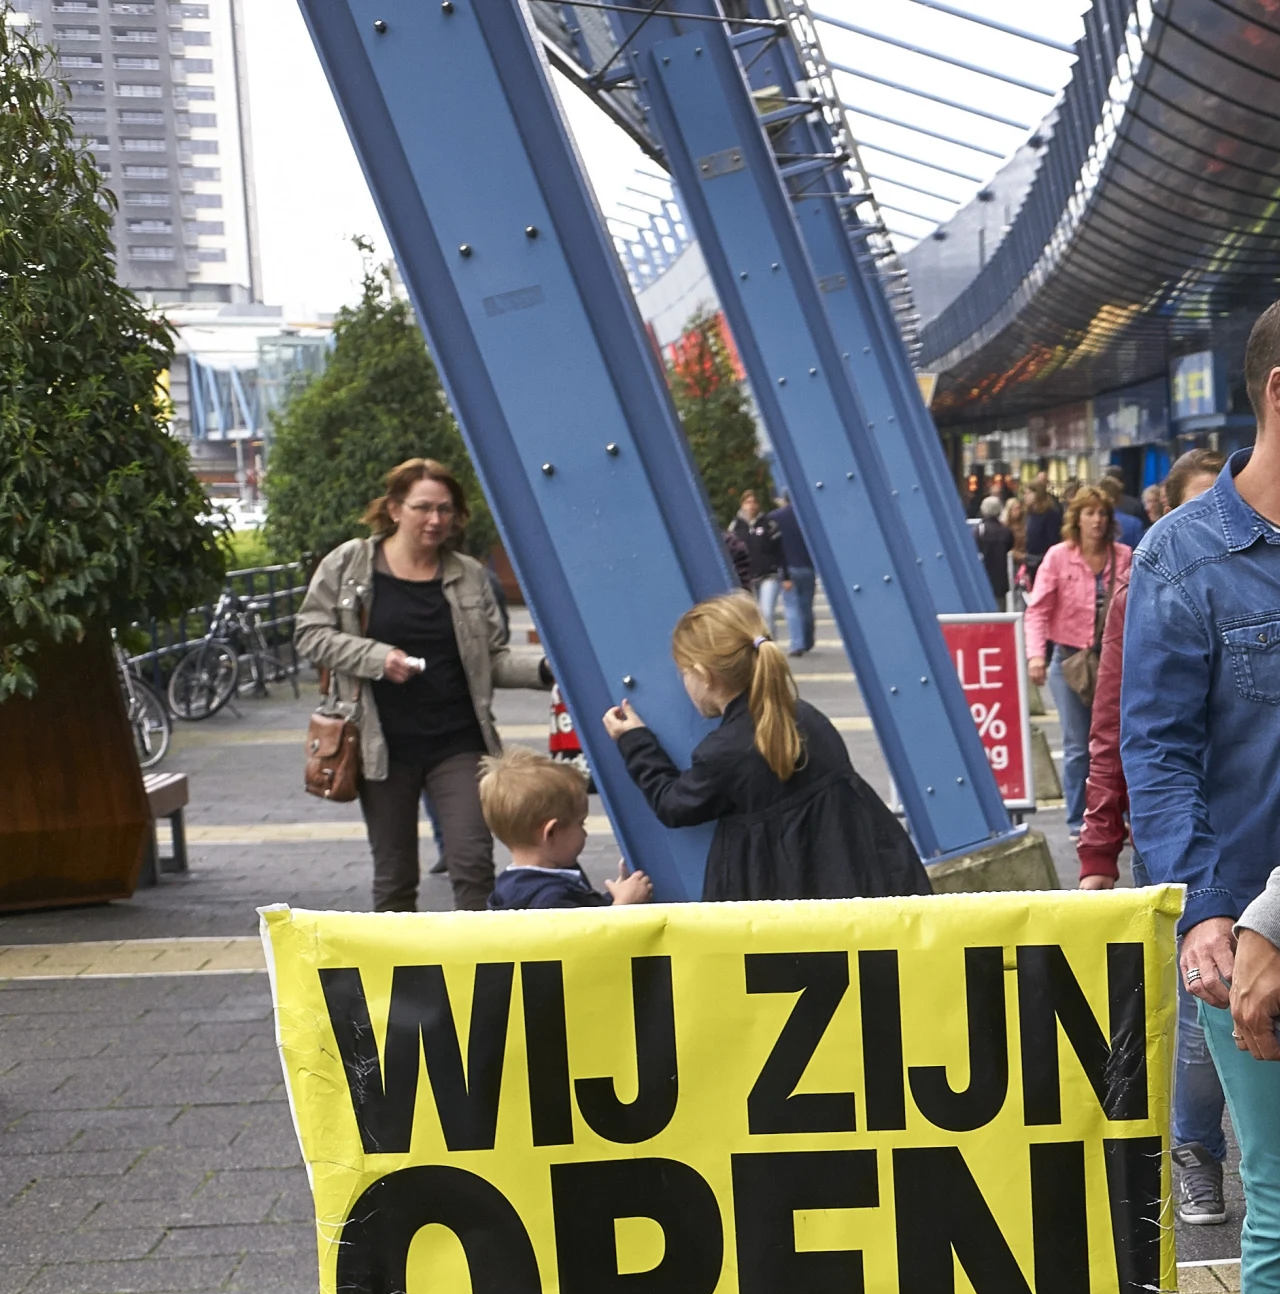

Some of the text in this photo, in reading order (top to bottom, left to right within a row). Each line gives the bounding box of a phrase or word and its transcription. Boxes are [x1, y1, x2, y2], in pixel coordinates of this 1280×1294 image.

[956, 648, 1003, 690] LE
[319, 956, 679, 1154] WIJ
[744, 942, 1149, 1135] ZIJN
